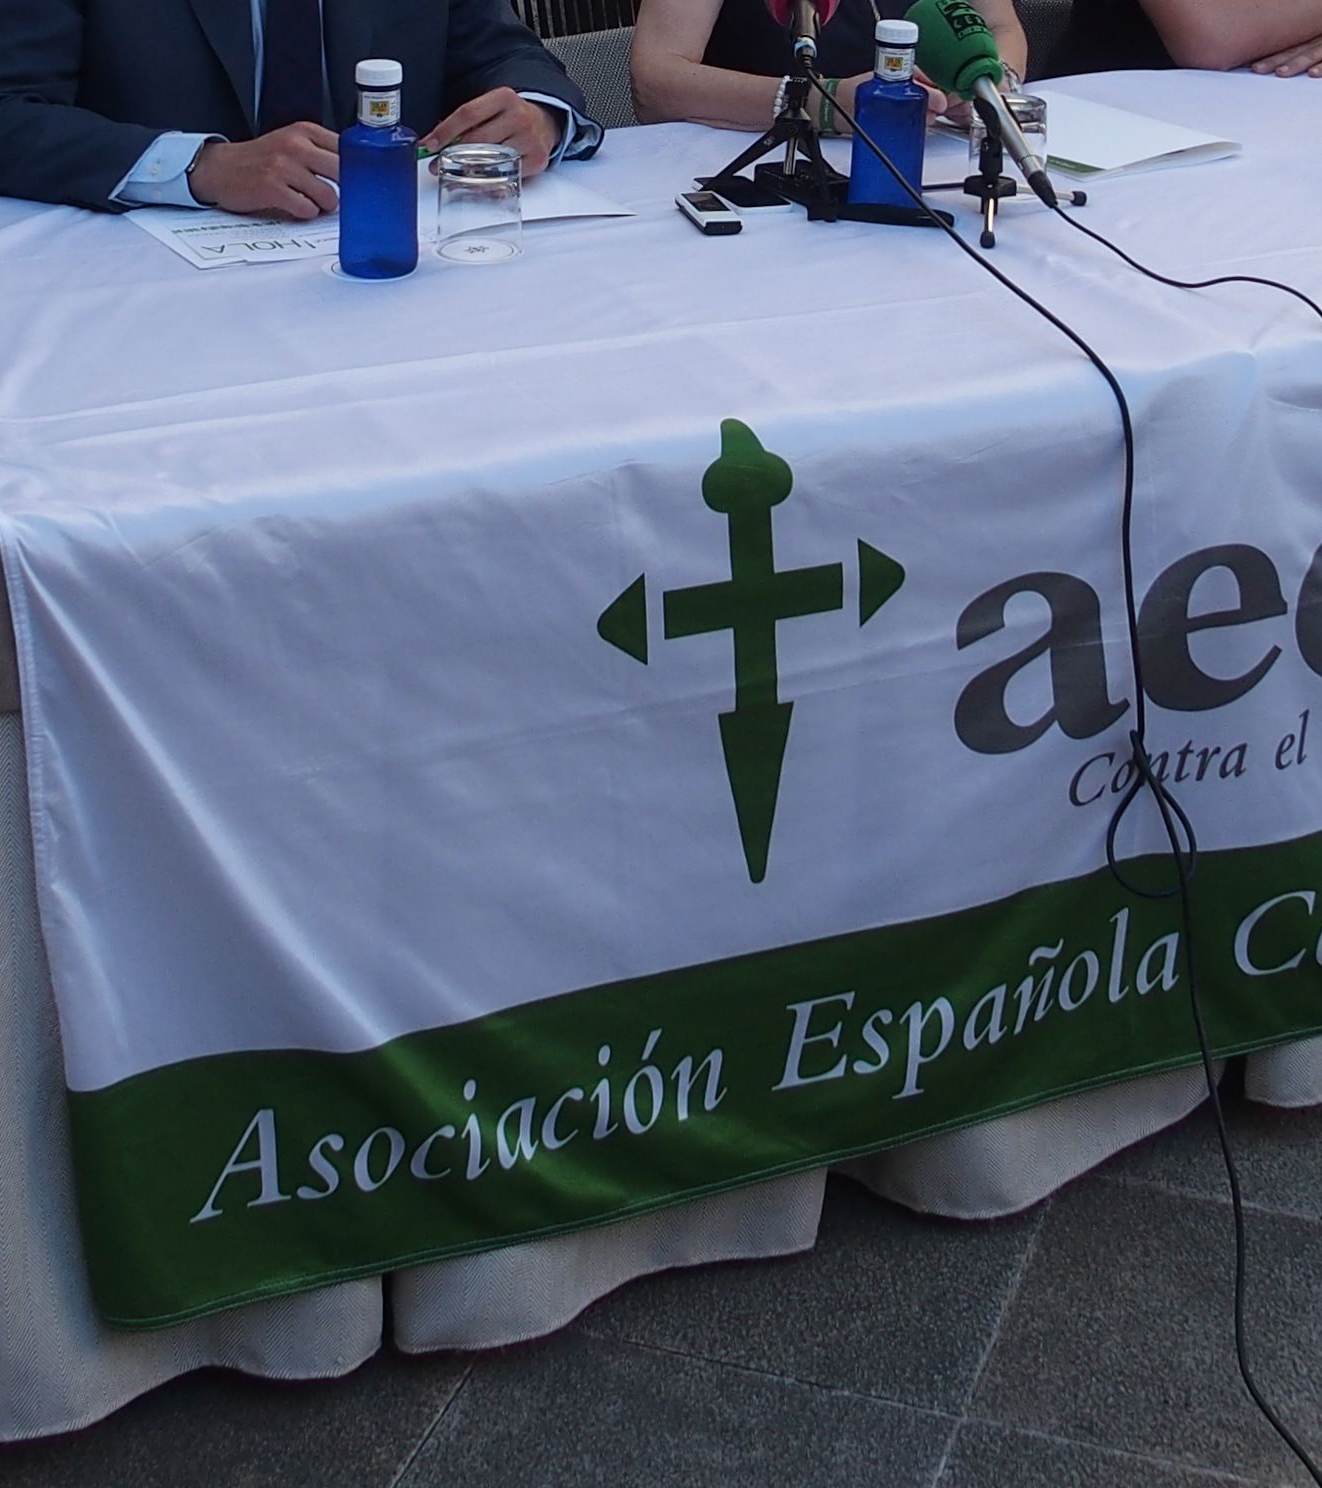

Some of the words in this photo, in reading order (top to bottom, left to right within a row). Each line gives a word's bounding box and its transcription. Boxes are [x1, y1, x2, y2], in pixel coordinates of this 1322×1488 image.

[1067, 740, 1247, 808] Contra
[1274, 726, 1309, 772] el
[190, 1029, 728, 1226] Asociación
[771, 905, 1181, 1100] Española
